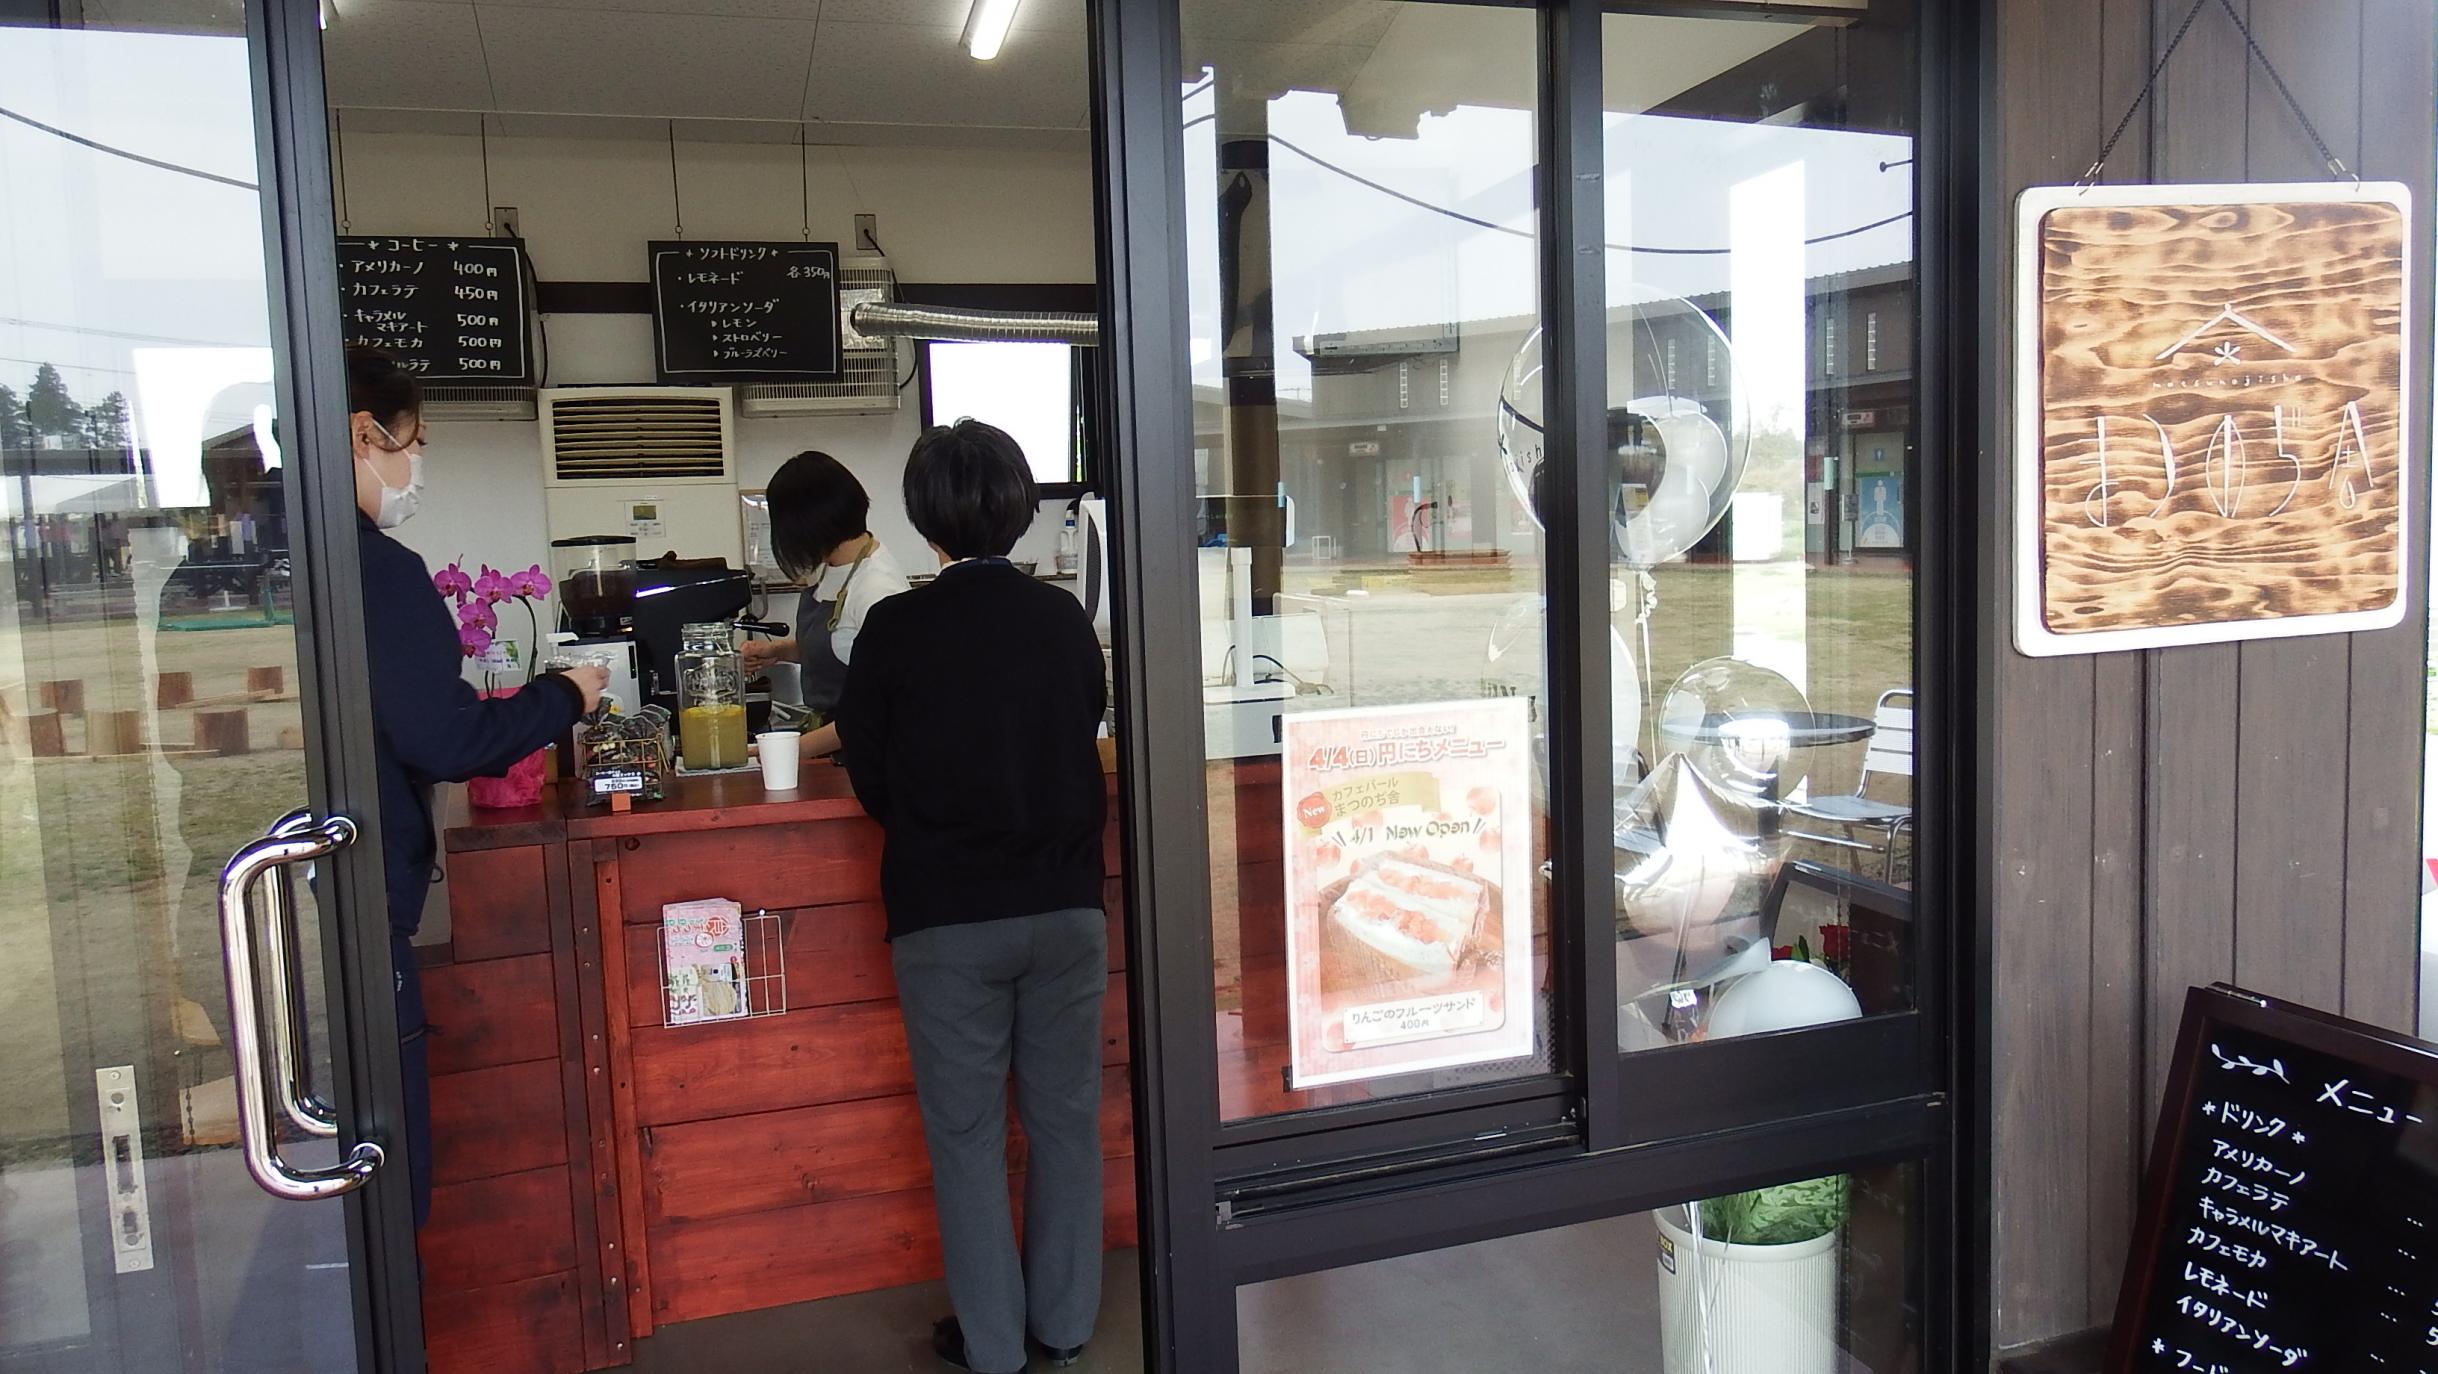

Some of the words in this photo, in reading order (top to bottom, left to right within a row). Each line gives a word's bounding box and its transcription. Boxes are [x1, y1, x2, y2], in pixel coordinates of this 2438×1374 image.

[388, 239, 438, 251] コーヒー
[700, 247, 767, 261] ソフトドリンク
[351, 260, 424, 275] アメリカーノ
[688, 271, 743, 285] レモネード
[352, 282, 419, 299] カフェラテ
[687, 298, 780, 314] イタリアンソーダ
[354, 309, 407, 323] キャラメル
[722, 318, 757, 328] レモン
[376, 321, 429, 333] マキアート
[358, 335, 424, 349] カフェモカ
[722, 331, 783, 343] ストロベリー
[1332, 776, 1398, 802] カフェバール
[1303, 805, 1325, 818] New
[1426, 820, 1470, 838] Open
[1352, 996, 1476, 1025] りんごのフルーツサンド
[2316, 1079, 2423, 1124] メニュー
[2222, 1101, 2286, 1138] ドリンク
[2213, 1139, 2305, 1186] アメリカーノ
[2201, 1167, 2290, 1211] カフェラテ
[2199, 1196, 2349, 1271] キャラメルマキアート
[2187, 1227, 2268, 1268] カフェモカ
[2184, 1261, 2269, 1309] レモネード
[2176, 1295, 2308, 1366] イタリアンソーダ
